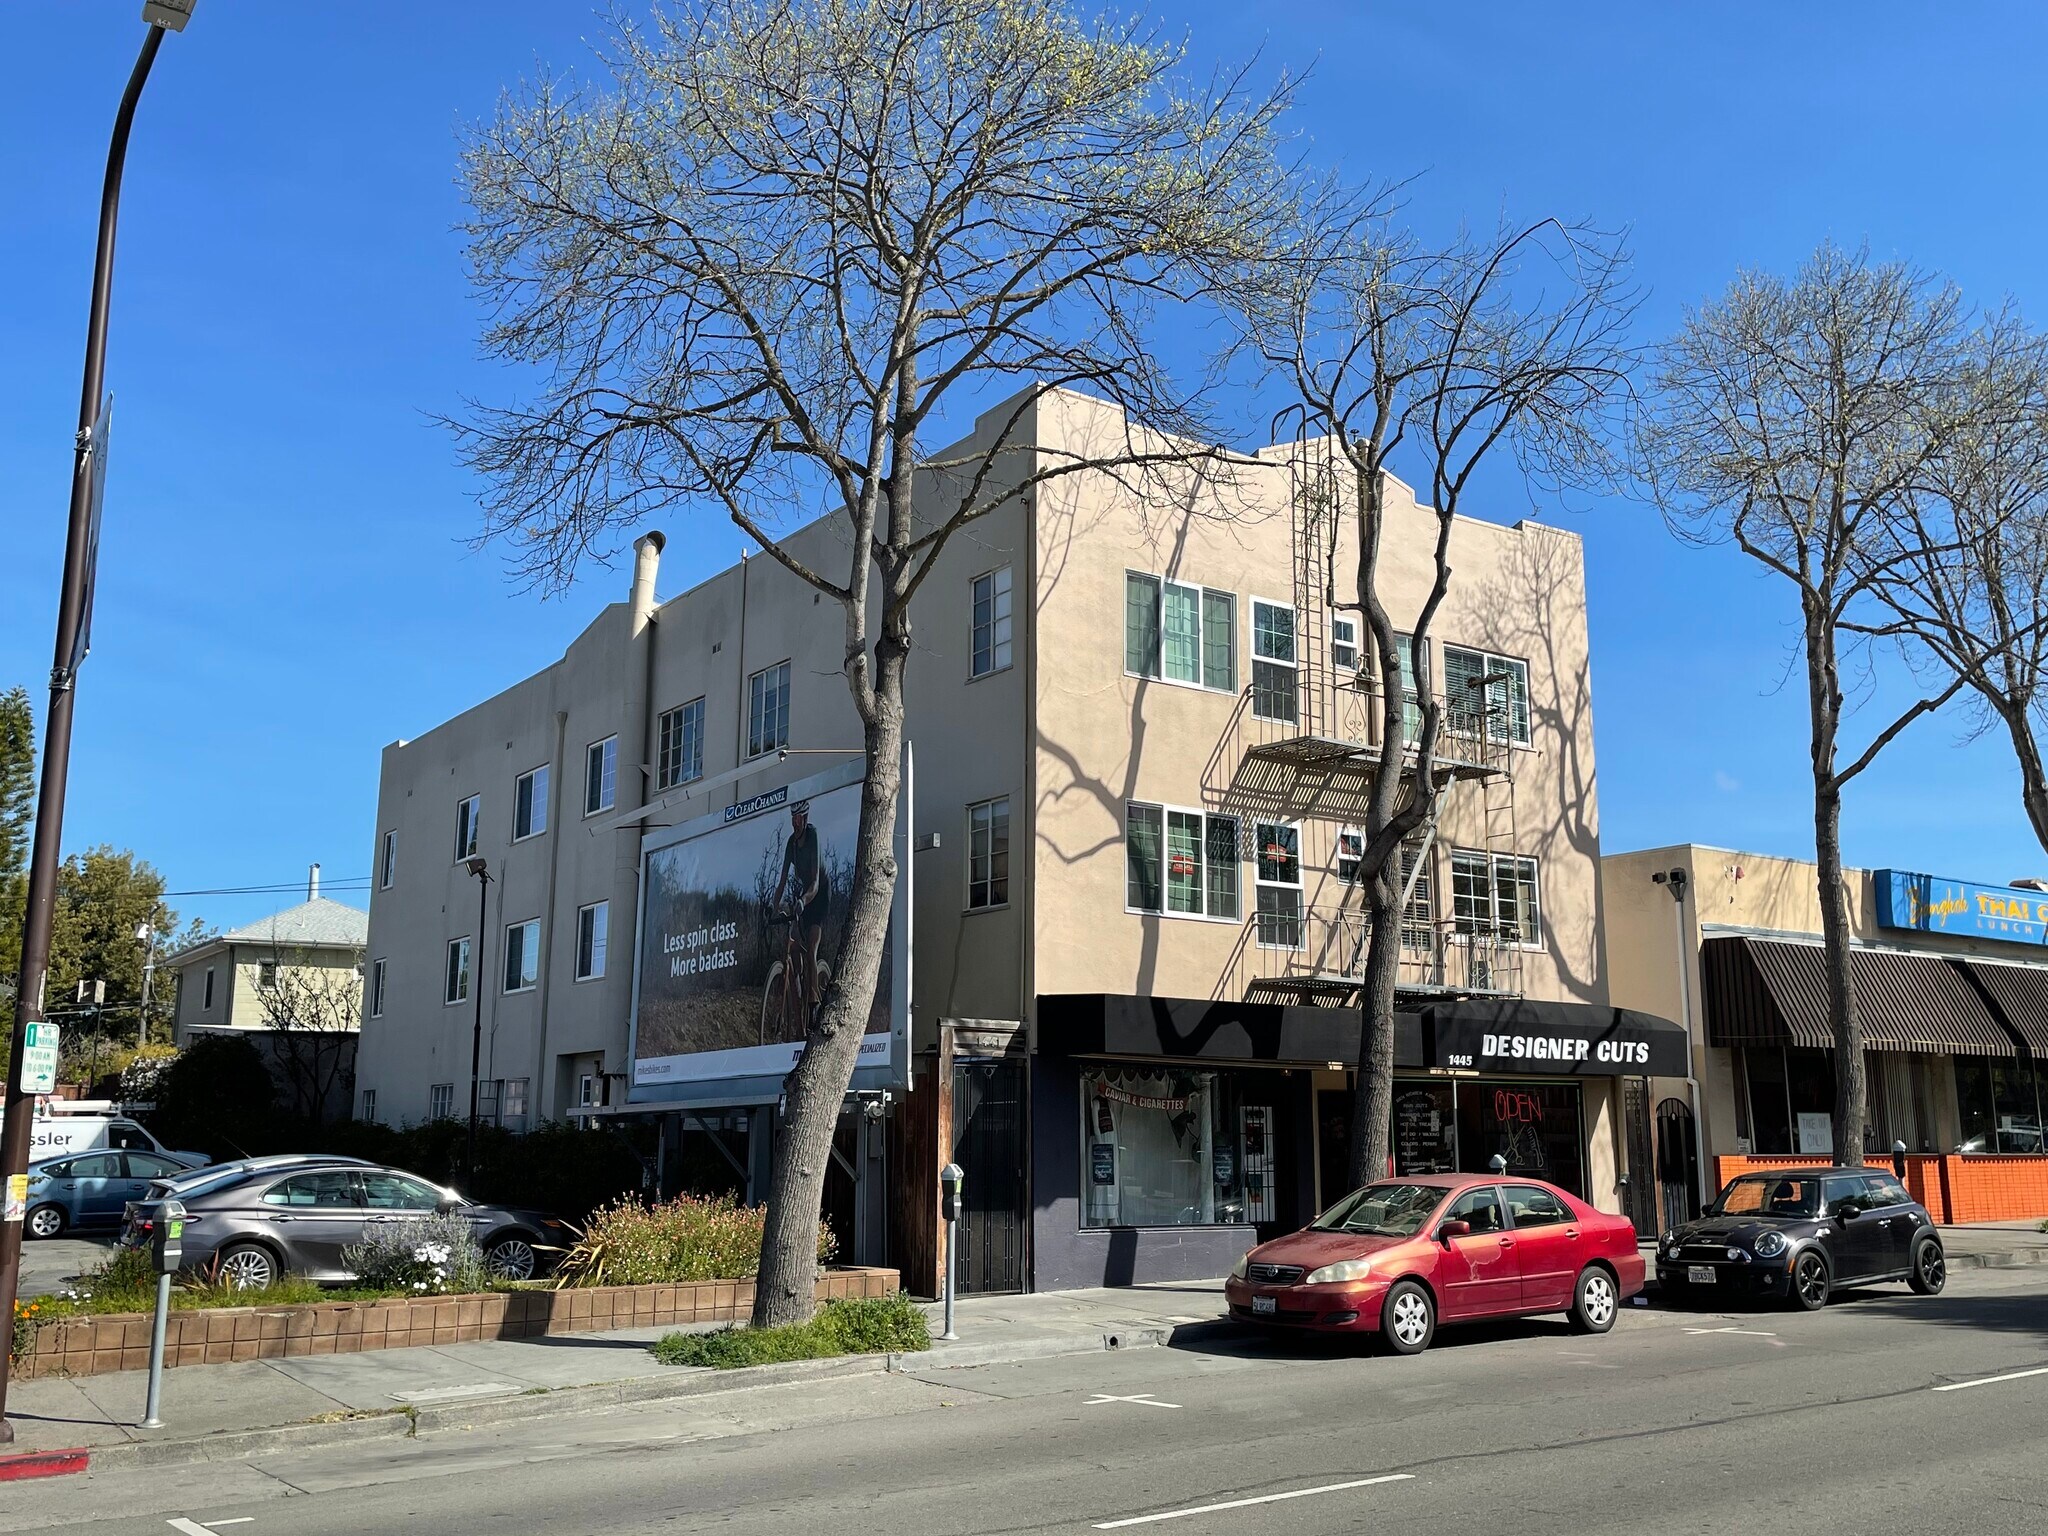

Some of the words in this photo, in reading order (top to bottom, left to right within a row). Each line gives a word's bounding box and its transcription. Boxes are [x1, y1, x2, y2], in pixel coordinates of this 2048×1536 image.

[1976, 894, 2030, 920] THAI
[663, 932, 685, 954] Less
[687, 923, 708, 953] spin
[710, 919, 739, 943] class.
[1977, 919, 2033, 935] LUNCH
[670, 956, 697, 978] More
[698, 946, 738, 973] badass.
[858, 1043, 886, 1054] PECIALIZED
[1449, 1055, 1473, 1066] 1445
[1482, 1034, 1590, 1061] DESIGNER
[1597, 1040, 1650, 1063] CUTS
[1105, 1086, 1131, 1104] CAVIAR
[1139, 1097, 1184, 1110] CIGARETTES
[1494, 1090, 1543, 1122] OPEN
[30, 1132, 72, 1146] ssler
